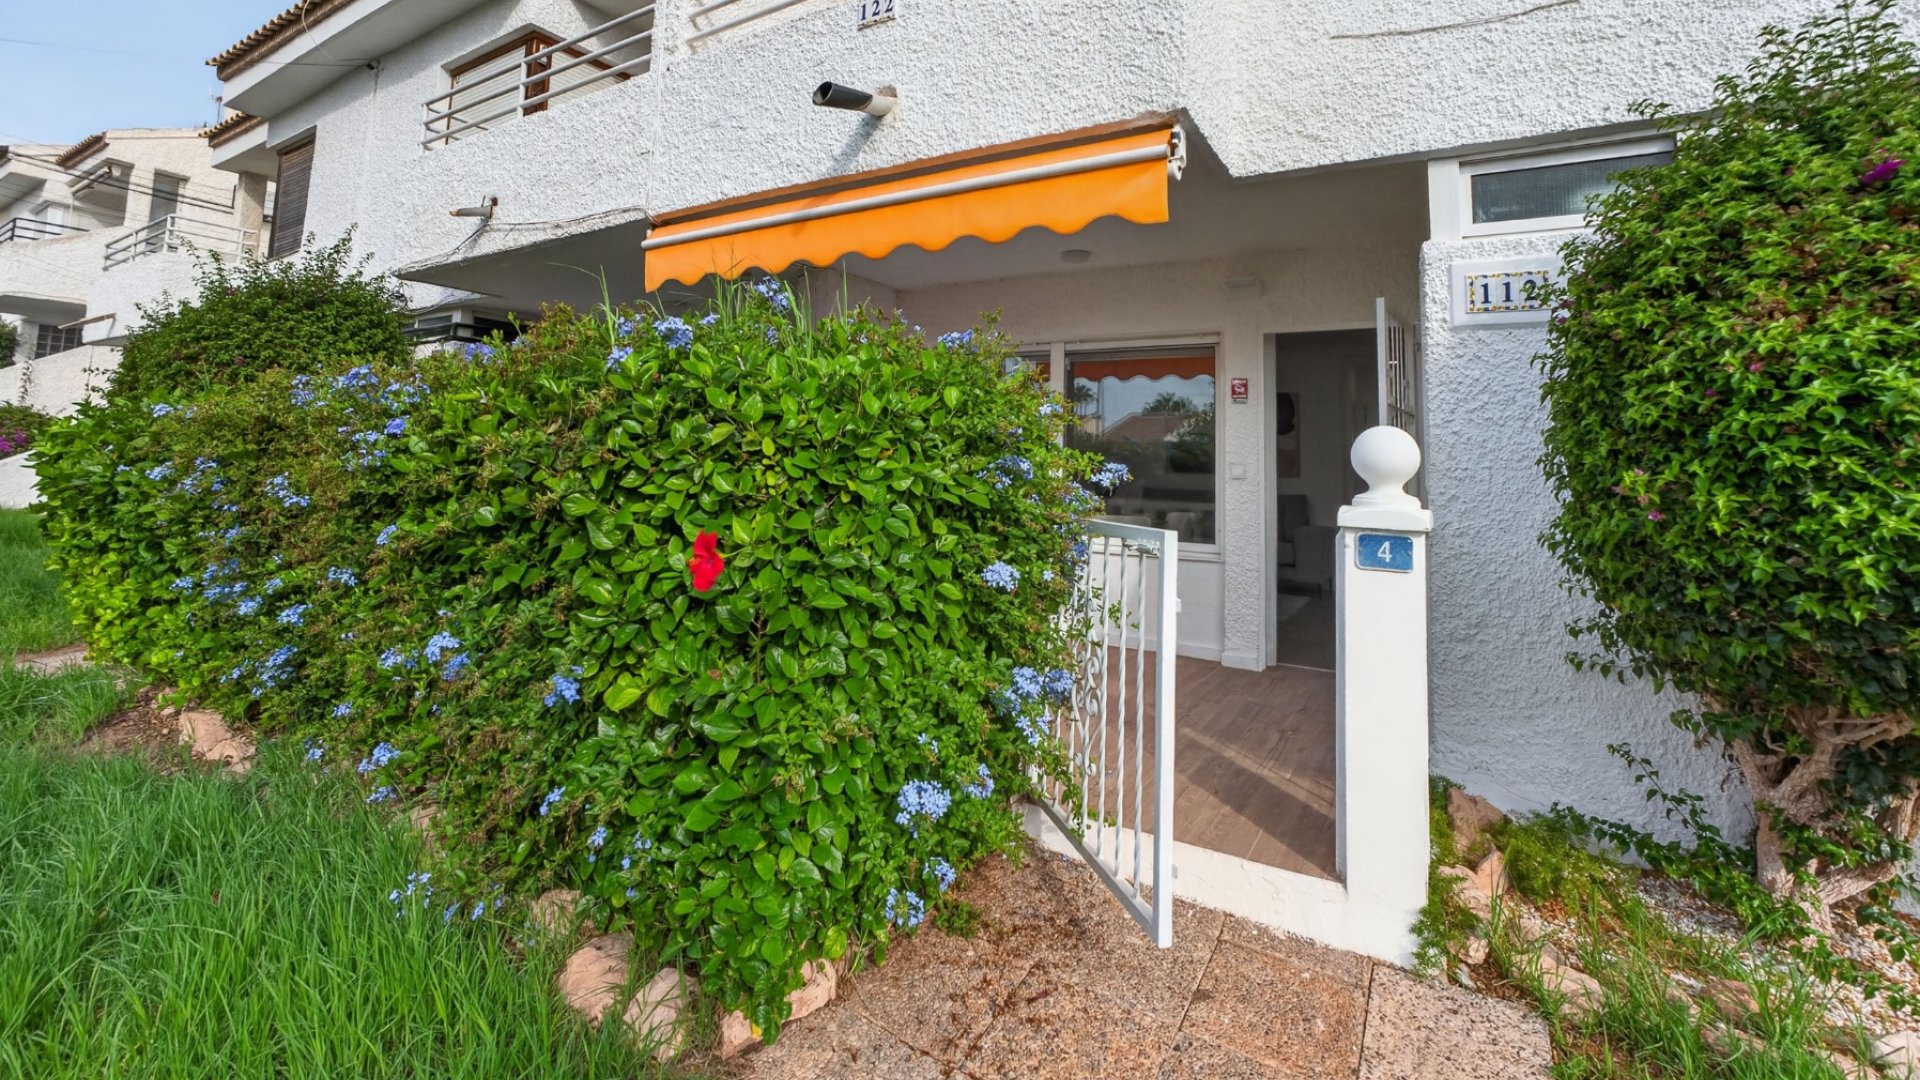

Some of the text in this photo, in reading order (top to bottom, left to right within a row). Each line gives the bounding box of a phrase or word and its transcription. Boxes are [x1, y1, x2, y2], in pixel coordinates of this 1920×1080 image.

[860, 0, 894, 21] 122
[1480, 279, 1538, 304] 112
[1377, 541, 1392, 563] 4
